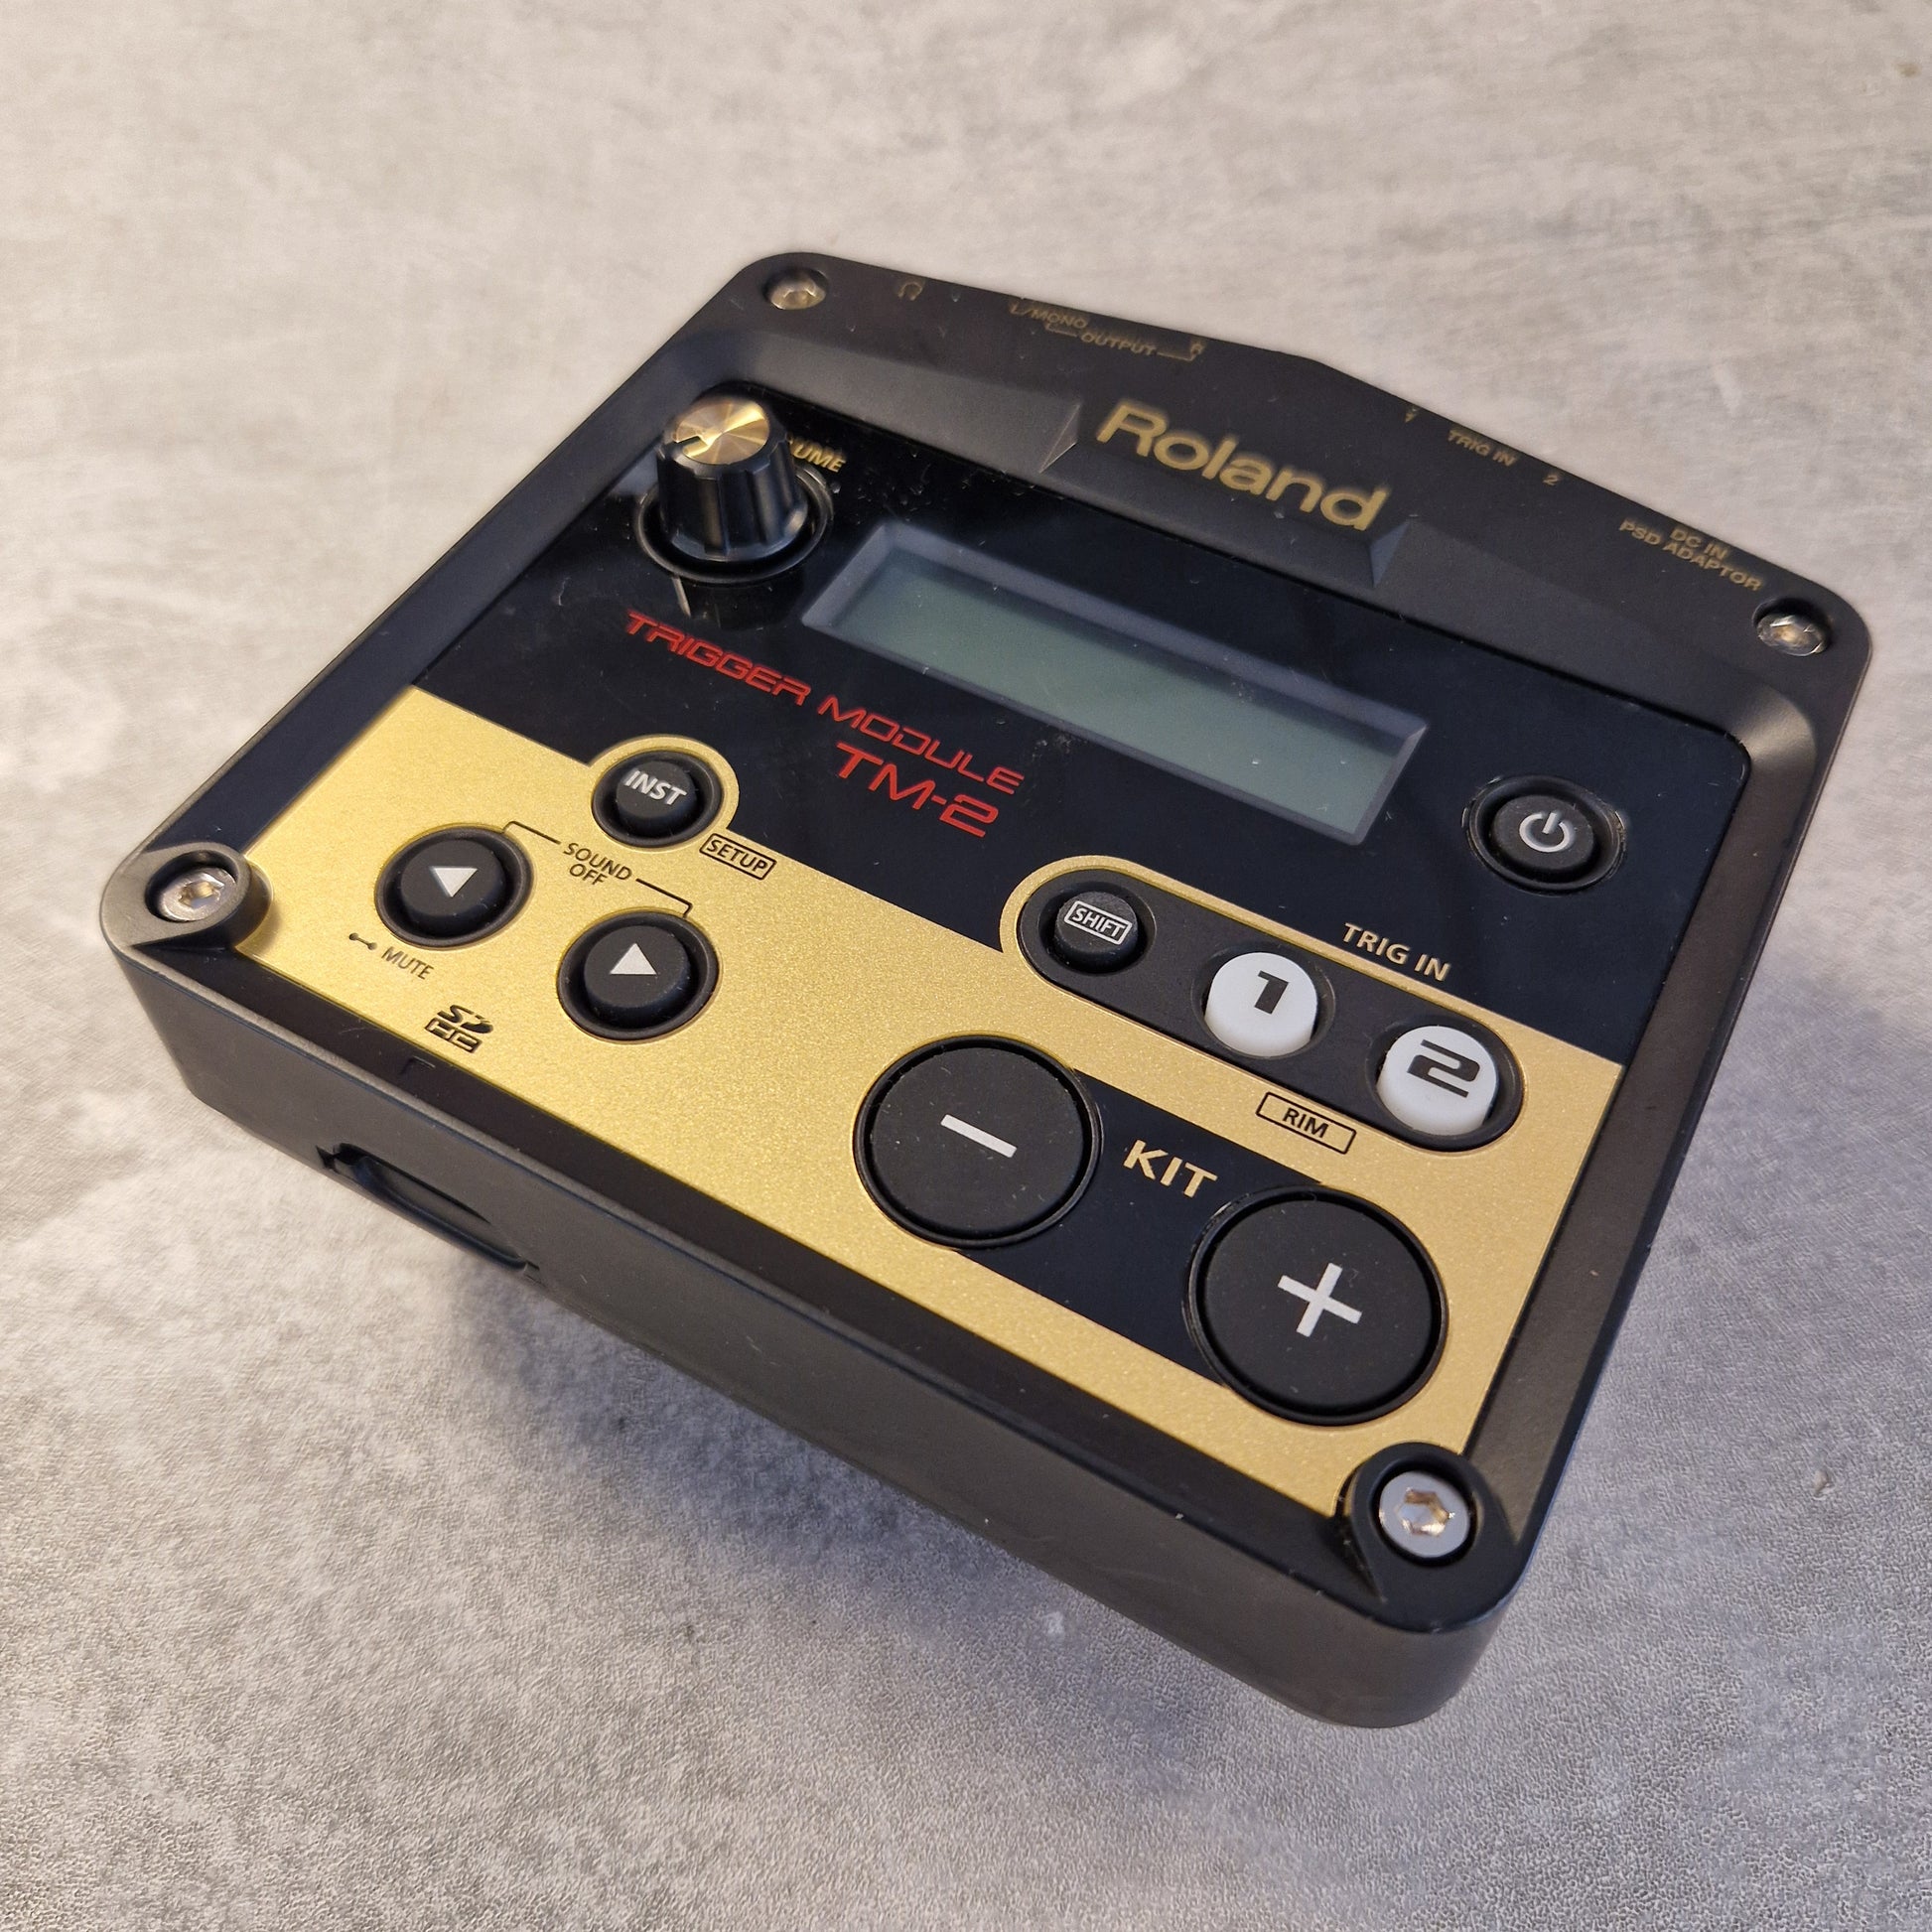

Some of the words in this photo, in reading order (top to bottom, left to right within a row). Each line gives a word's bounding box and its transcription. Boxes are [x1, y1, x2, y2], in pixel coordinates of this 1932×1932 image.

[1080, 332, 1157, 356] OUTPUT
[1096, 400, 1388, 531] Roland
[1448, 429, 1489, 457] TRIG
[1493, 450, 1517, 467] IN
[1543, 474, 1560, 486] 2
[1619, 518, 1662, 546] PSD
[1663, 541, 1763, 592] ADAPTOR
[1670, 524, 1702, 549] DC
[1705, 541, 1729, 560] IN
[625, 609, 812, 707] TRIGGER
[817, 695, 1025, 794] MODULE
[624, 769, 687, 806] INST
[836, 742, 1000, 838] TM-2
[564, 842, 632, 882] SOUND
[569, 864, 609, 887] OFF
[705, 838, 770, 875] SETUP
[1073, 905, 1126, 939] SHIFT
[380, 946, 435, 981] MUTE
[1342, 922, 1410, 966] TRIG
[1414, 953, 1451, 983] IN
[1253, 970, 1290, 1015] 1
[1406, 1039, 1481, 1099] 2
[1281, 1107, 1330, 1139] RIM
[1122, 1139, 1218, 1198] KIT
